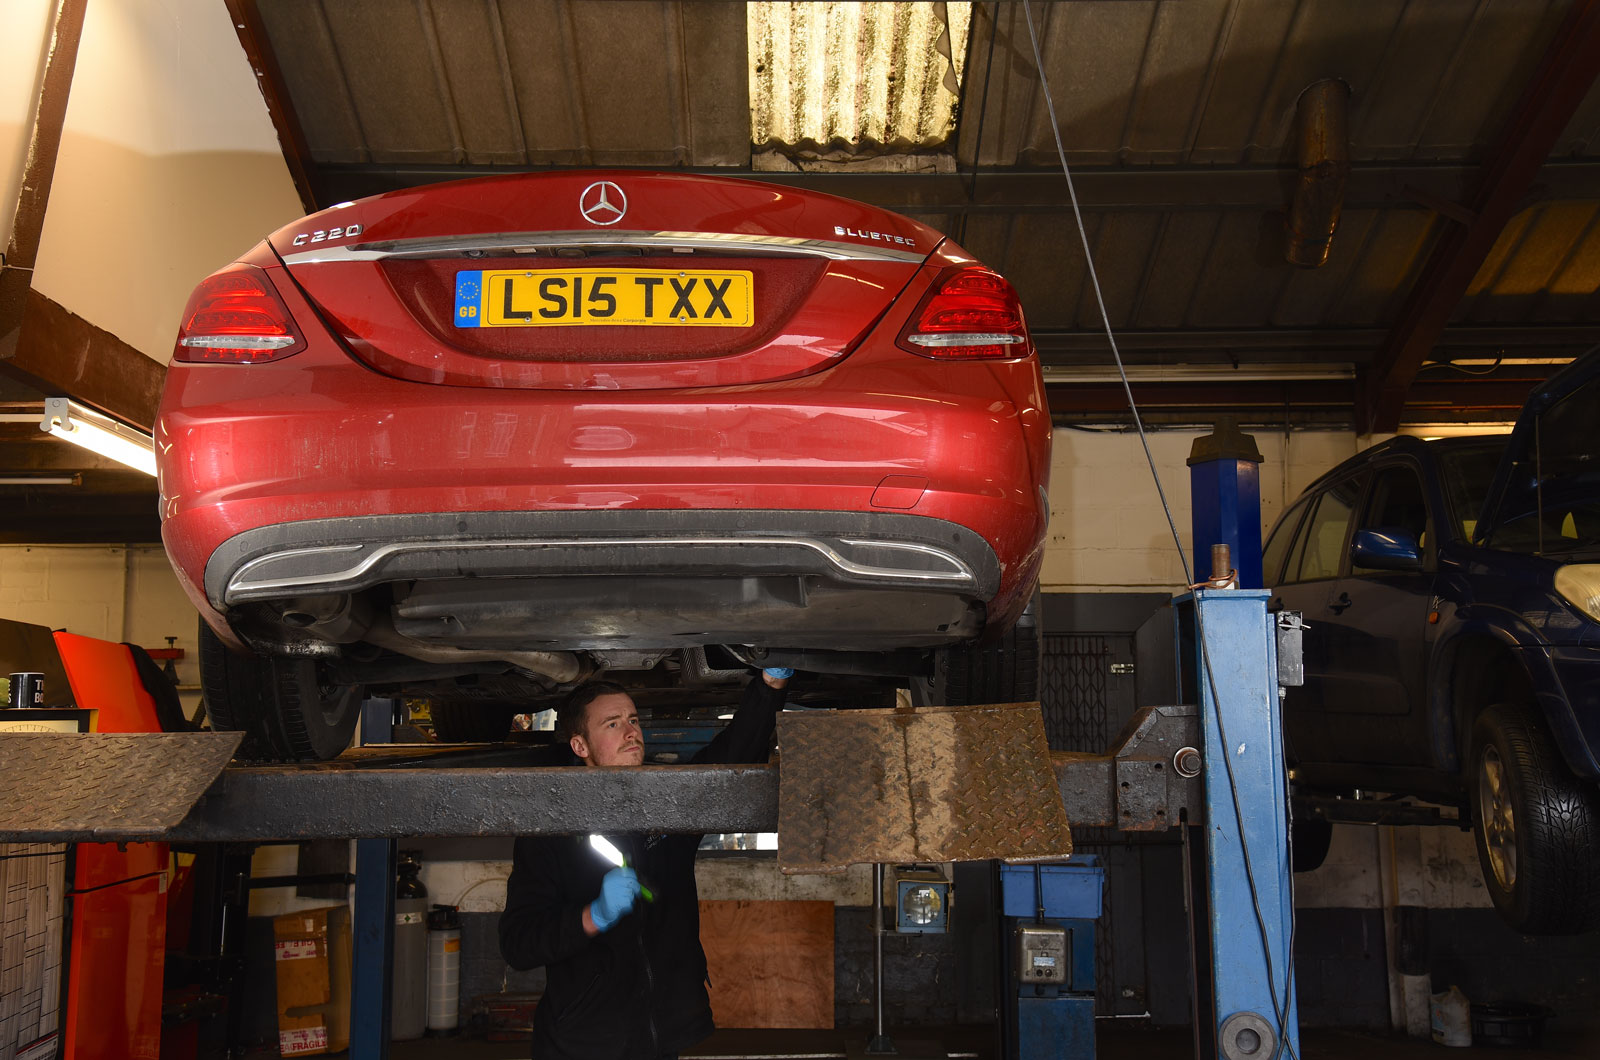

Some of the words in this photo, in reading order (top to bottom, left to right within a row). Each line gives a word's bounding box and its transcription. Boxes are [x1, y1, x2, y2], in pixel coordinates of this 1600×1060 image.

[834, 226, 916, 247] BLUETEC
[635, 277, 733, 319] TXX
[459, 306, 477, 318] GB
